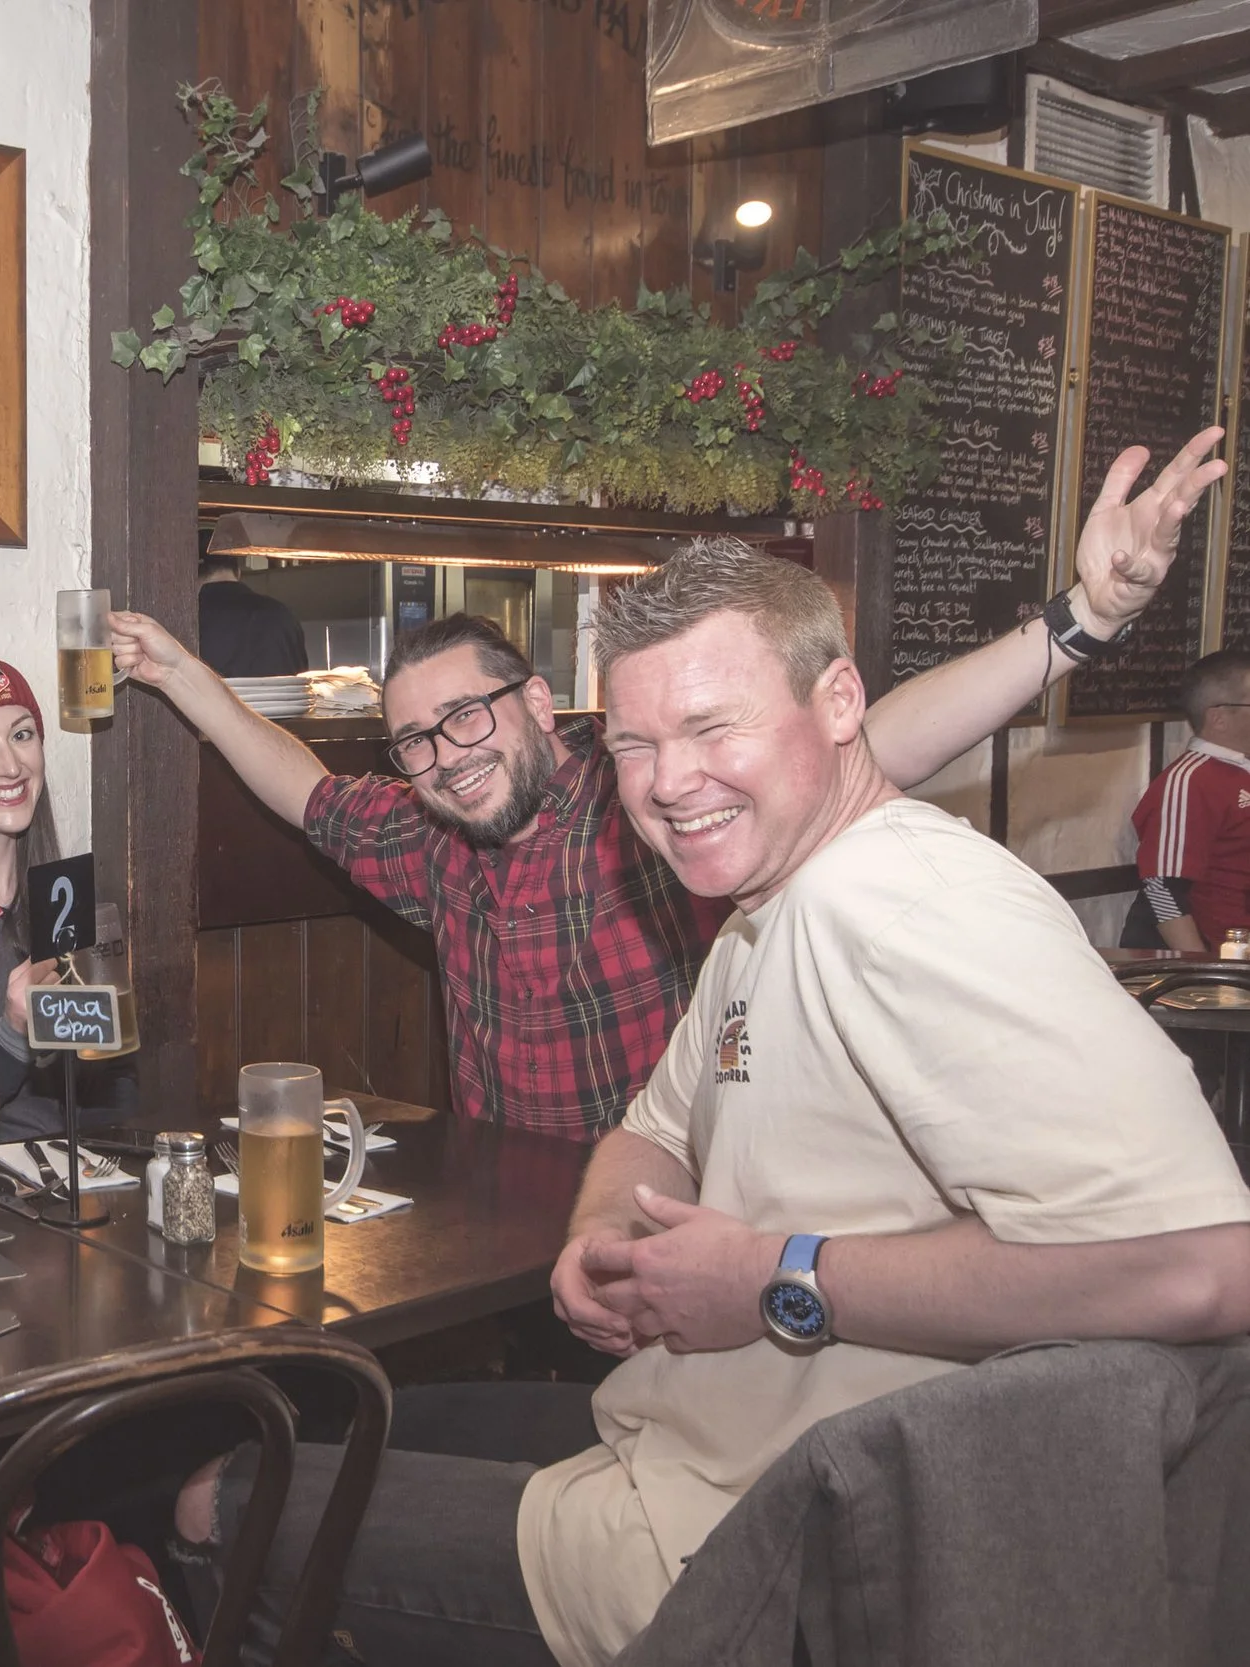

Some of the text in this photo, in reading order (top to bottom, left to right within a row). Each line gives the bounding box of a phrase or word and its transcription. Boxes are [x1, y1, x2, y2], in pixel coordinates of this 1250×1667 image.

[945, 171, 1005, 216] Christmas
[1010, 194, 1021, 219] in
[1023, 188, 1066, 257] July!
[894, 600, 916, 617] URRY
[934, 602, 951, 617] THE
[932, 625, 950, 646] Beef
[85, 684, 107, 694] Asahi
[51, 876, 74, 943] 2
[40, 995, 110, 1021] Gina
[54, 1018, 103, 1044] 6pm
[281, 1220, 314, 1238] Asahi
